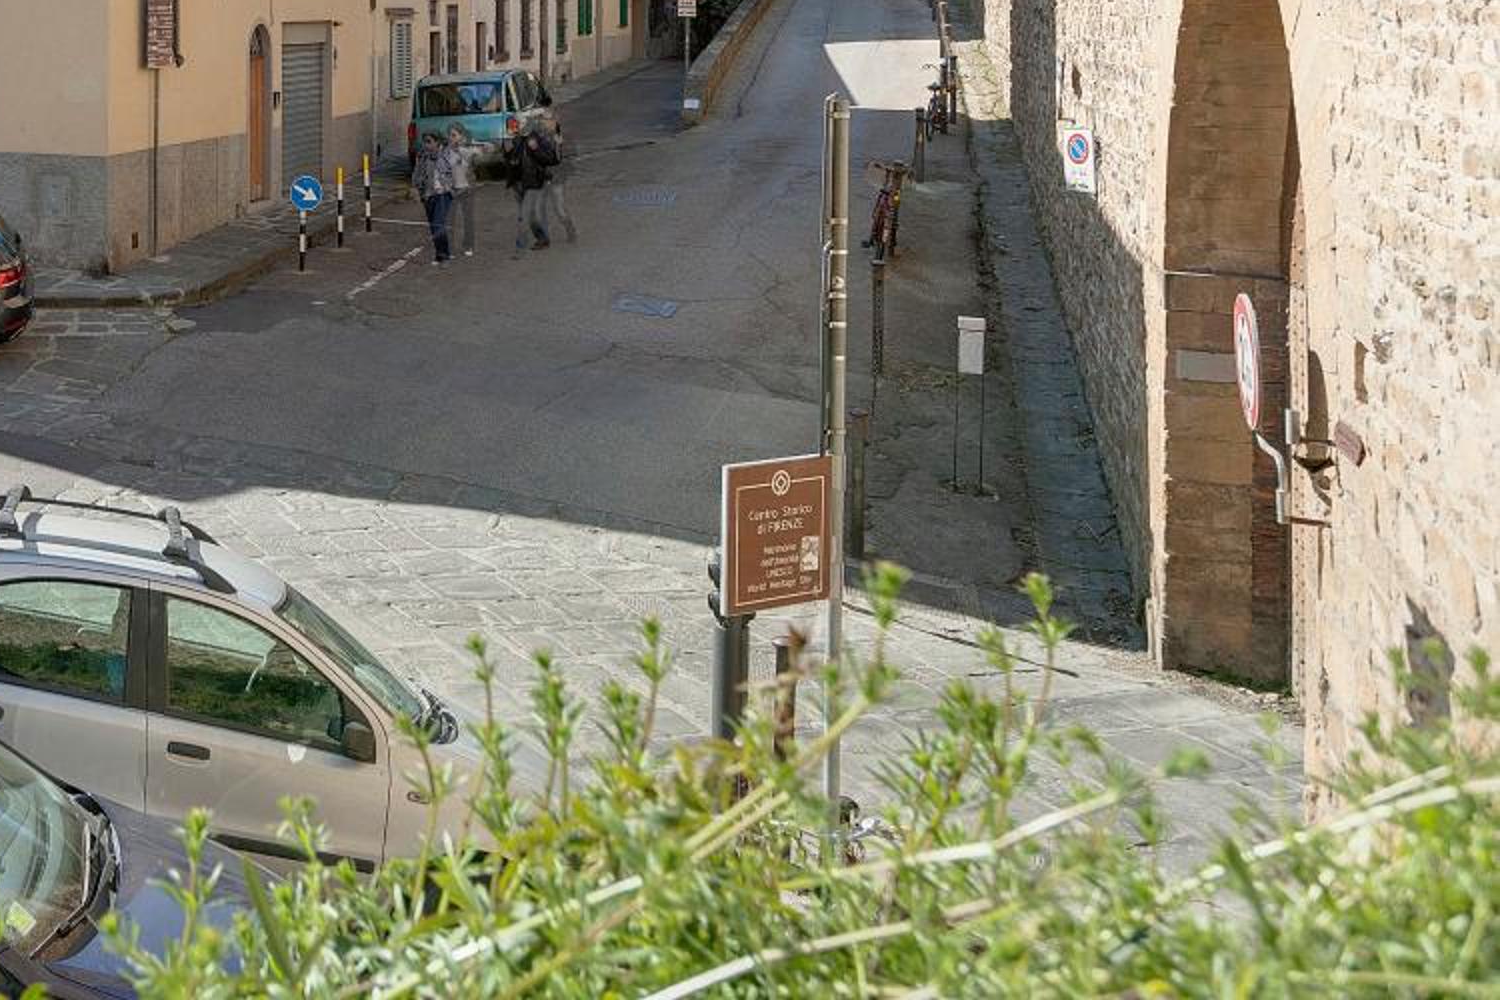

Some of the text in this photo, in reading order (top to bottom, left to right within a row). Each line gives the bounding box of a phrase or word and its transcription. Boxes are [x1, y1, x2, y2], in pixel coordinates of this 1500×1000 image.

[748, 504, 813, 521] Centro Storico
[768, 518, 804, 533] FIRENZE
